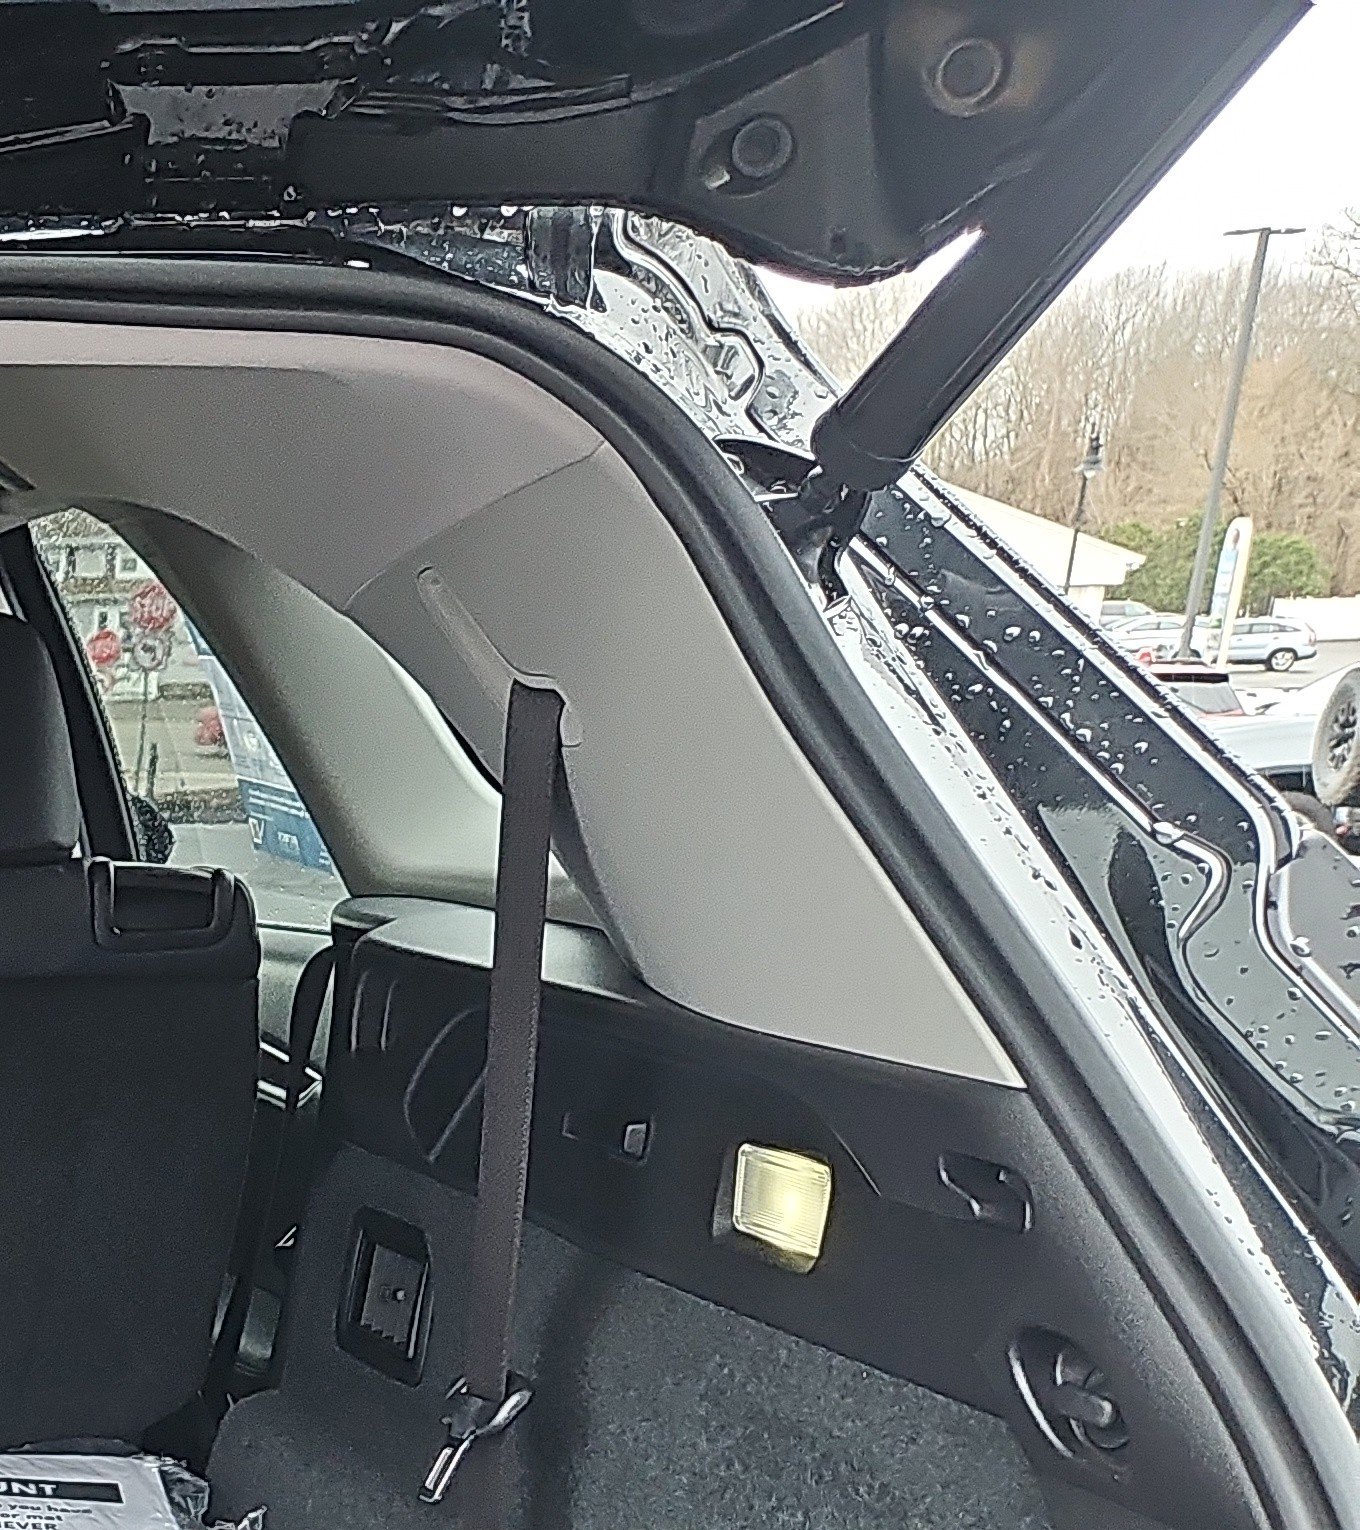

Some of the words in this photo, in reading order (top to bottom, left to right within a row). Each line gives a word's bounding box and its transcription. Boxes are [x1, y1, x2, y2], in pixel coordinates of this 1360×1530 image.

[8, 1503, 42, 1513] you
[47, 1503, 93, 1515] have
[25, 1512, 64, 1522] mat
